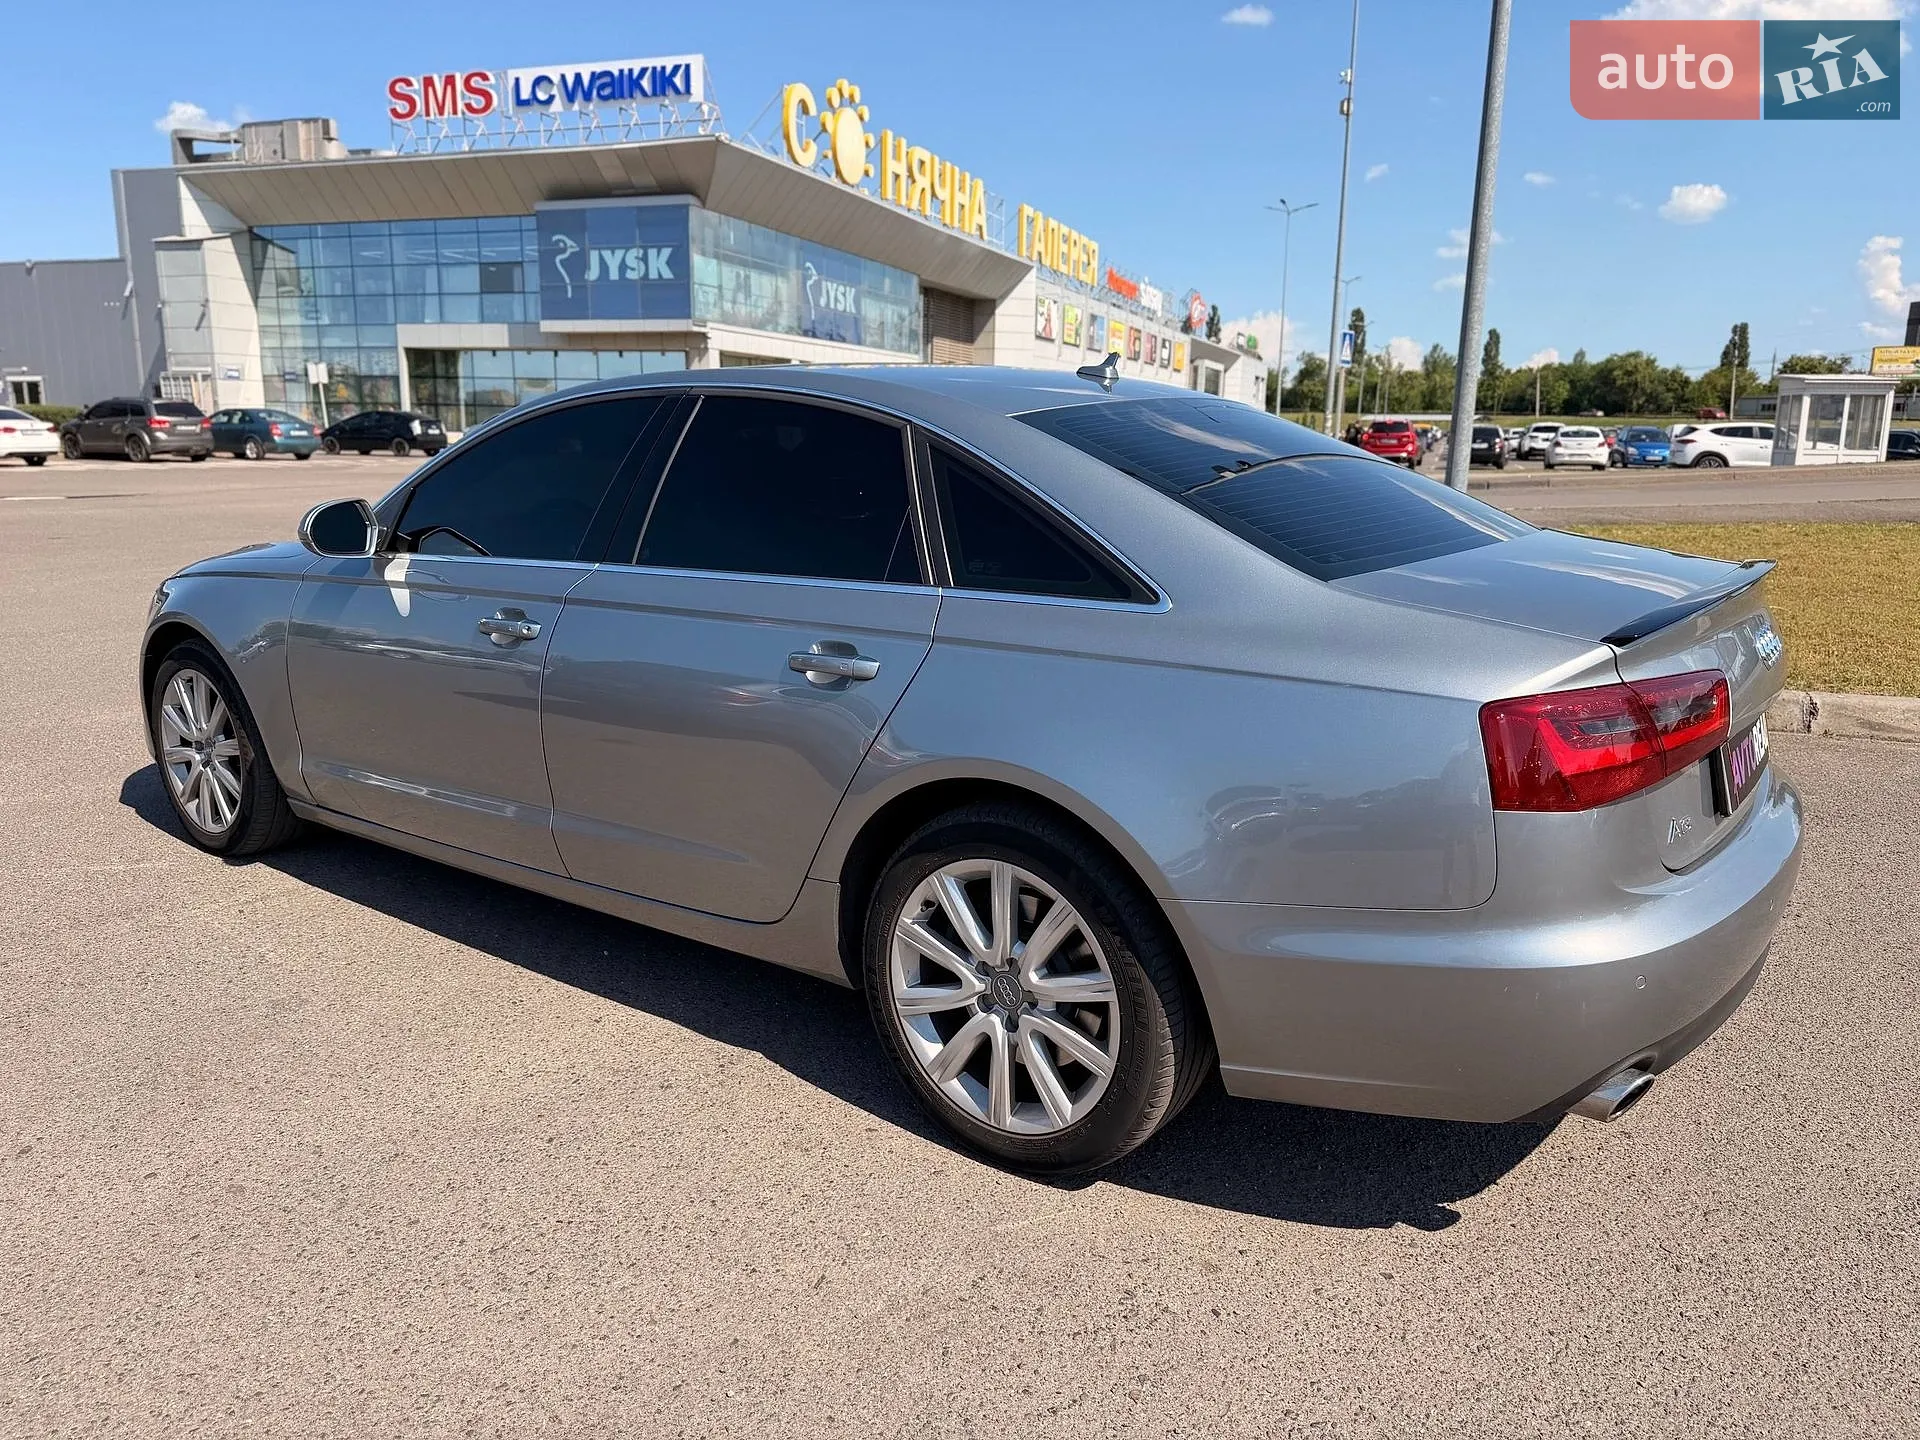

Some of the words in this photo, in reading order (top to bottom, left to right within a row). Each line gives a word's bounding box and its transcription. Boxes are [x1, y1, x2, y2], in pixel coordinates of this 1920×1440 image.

[388, 70, 495, 121] SMS
[514, 74, 556, 107] LC
[1017, 202, 1099, 287] ГАЛЕРЕЯ
[584, 247, 675, 281] JYSK
[819, 279, 857, 314] JYSK
